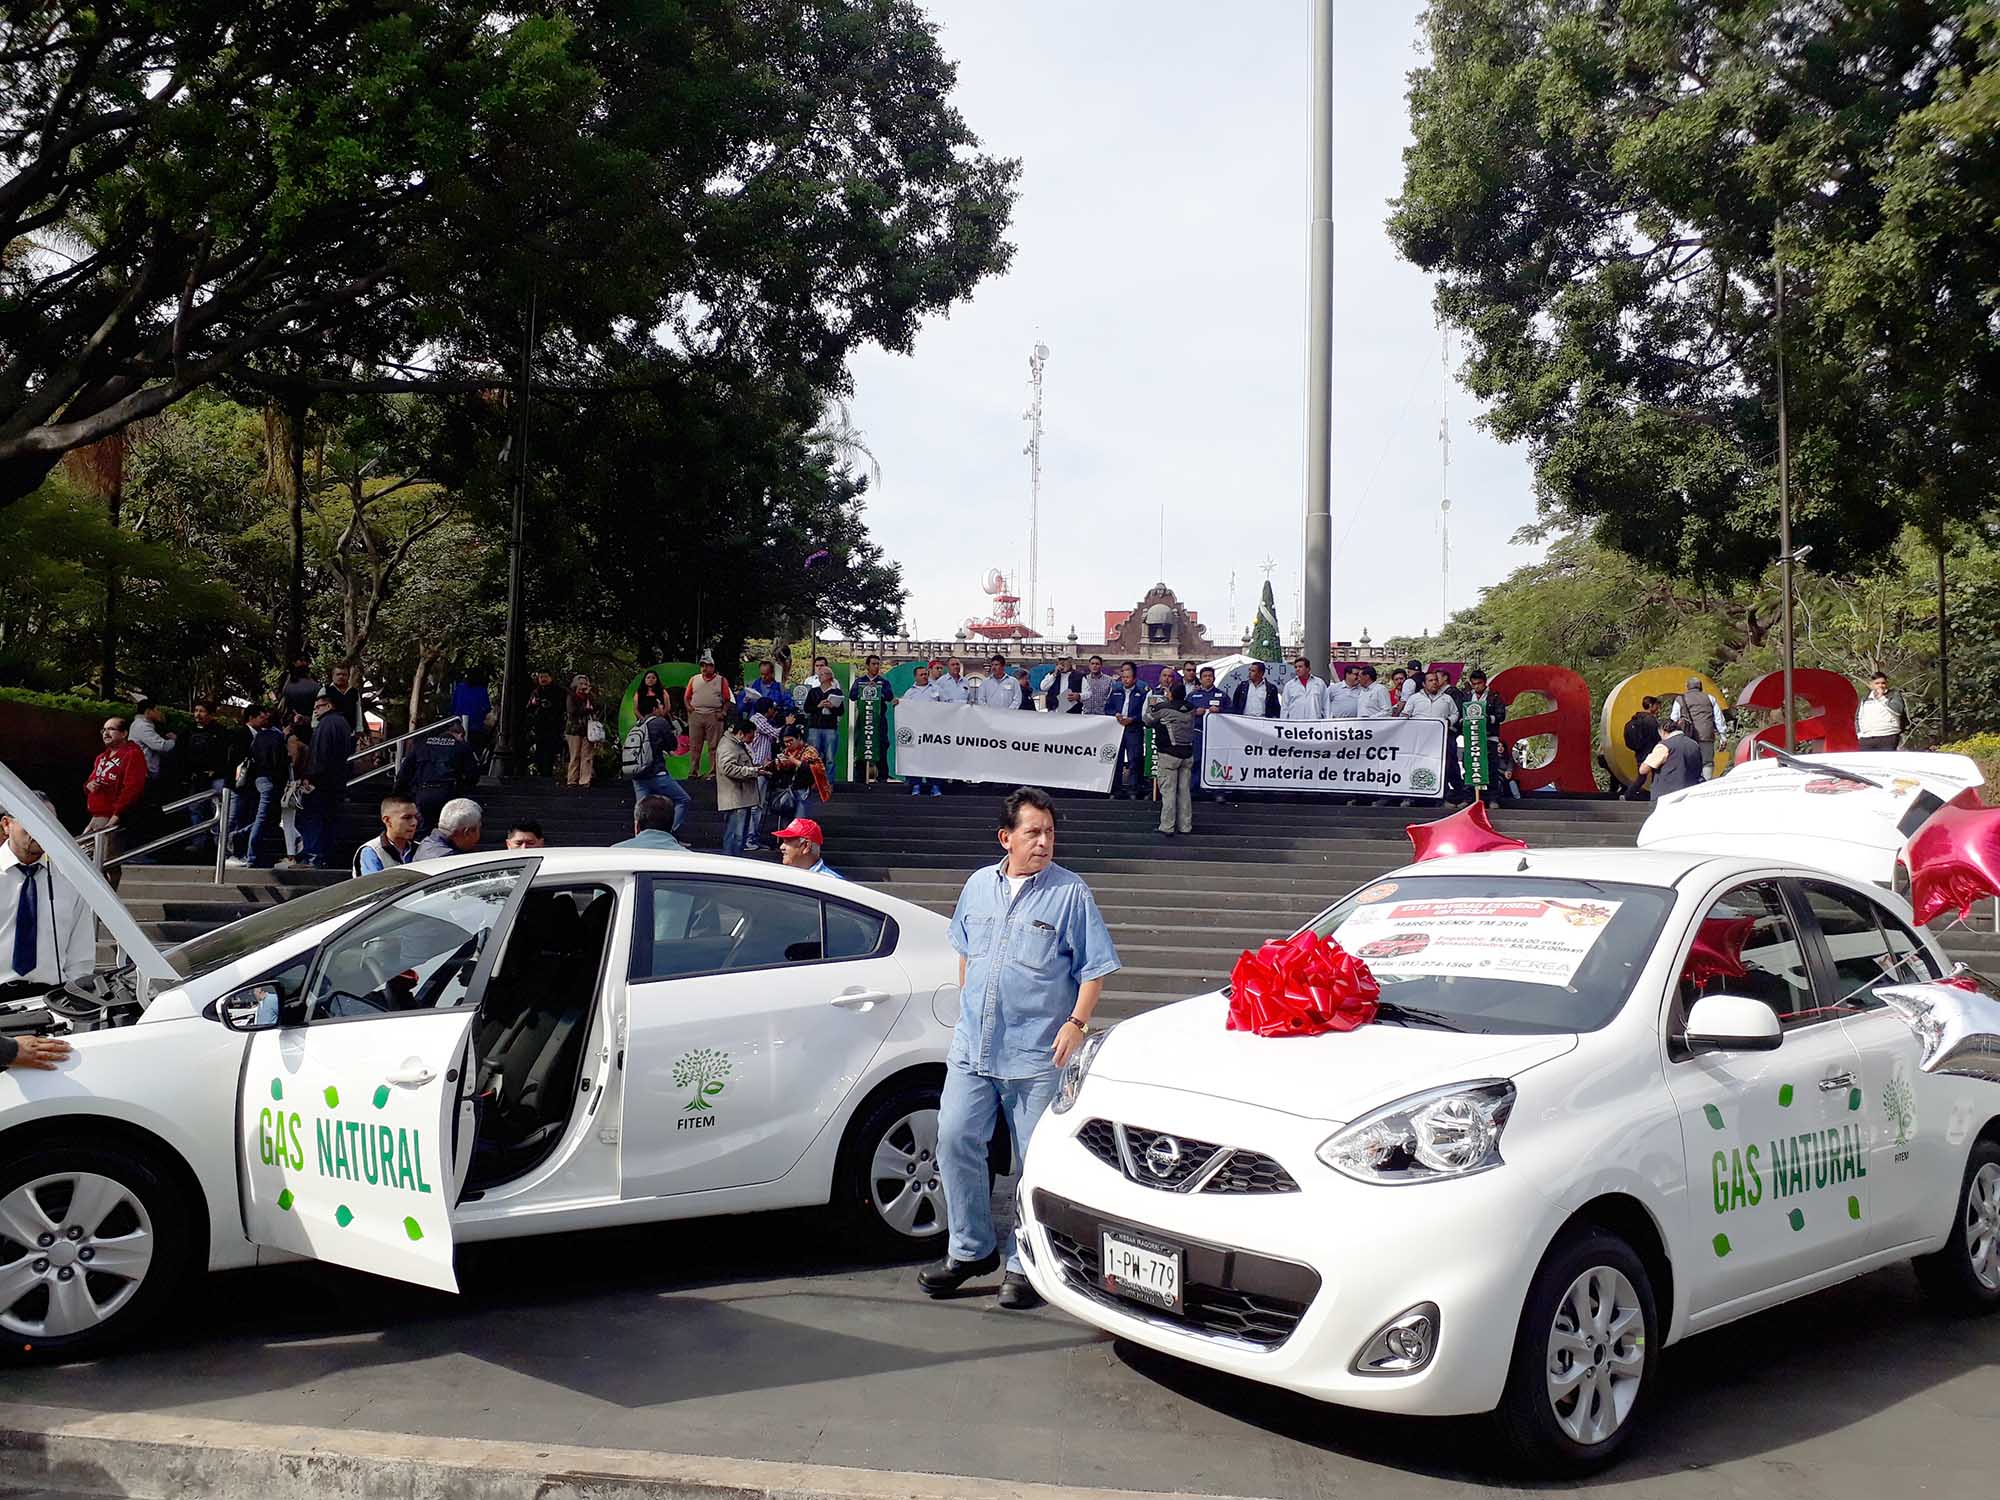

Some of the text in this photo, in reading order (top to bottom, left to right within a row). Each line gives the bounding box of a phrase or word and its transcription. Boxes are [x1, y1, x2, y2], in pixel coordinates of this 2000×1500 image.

[864, 700, 874, 760] TELEFONISTAS
[918, 733, 1097, 757] ¡MAS UNIDOS QUE NUNCA!
[1274, 725, 1373, 741] Telefonistas
[1244, 744, 1400, 761] en defensa del CCT
[1470, 719, 1481, 783] TELEFONISTAS
[1240, 764, 1401, 787] y materia de trabajo
[676, 1115, 716, 1131] FITEM
[260, 1106, 432, 1194] GAS NATURAL
[1712, 1123, 1867, 1215] GAS NATURAL
[1110, 1247, 1175, 1290] 1-PW-779
